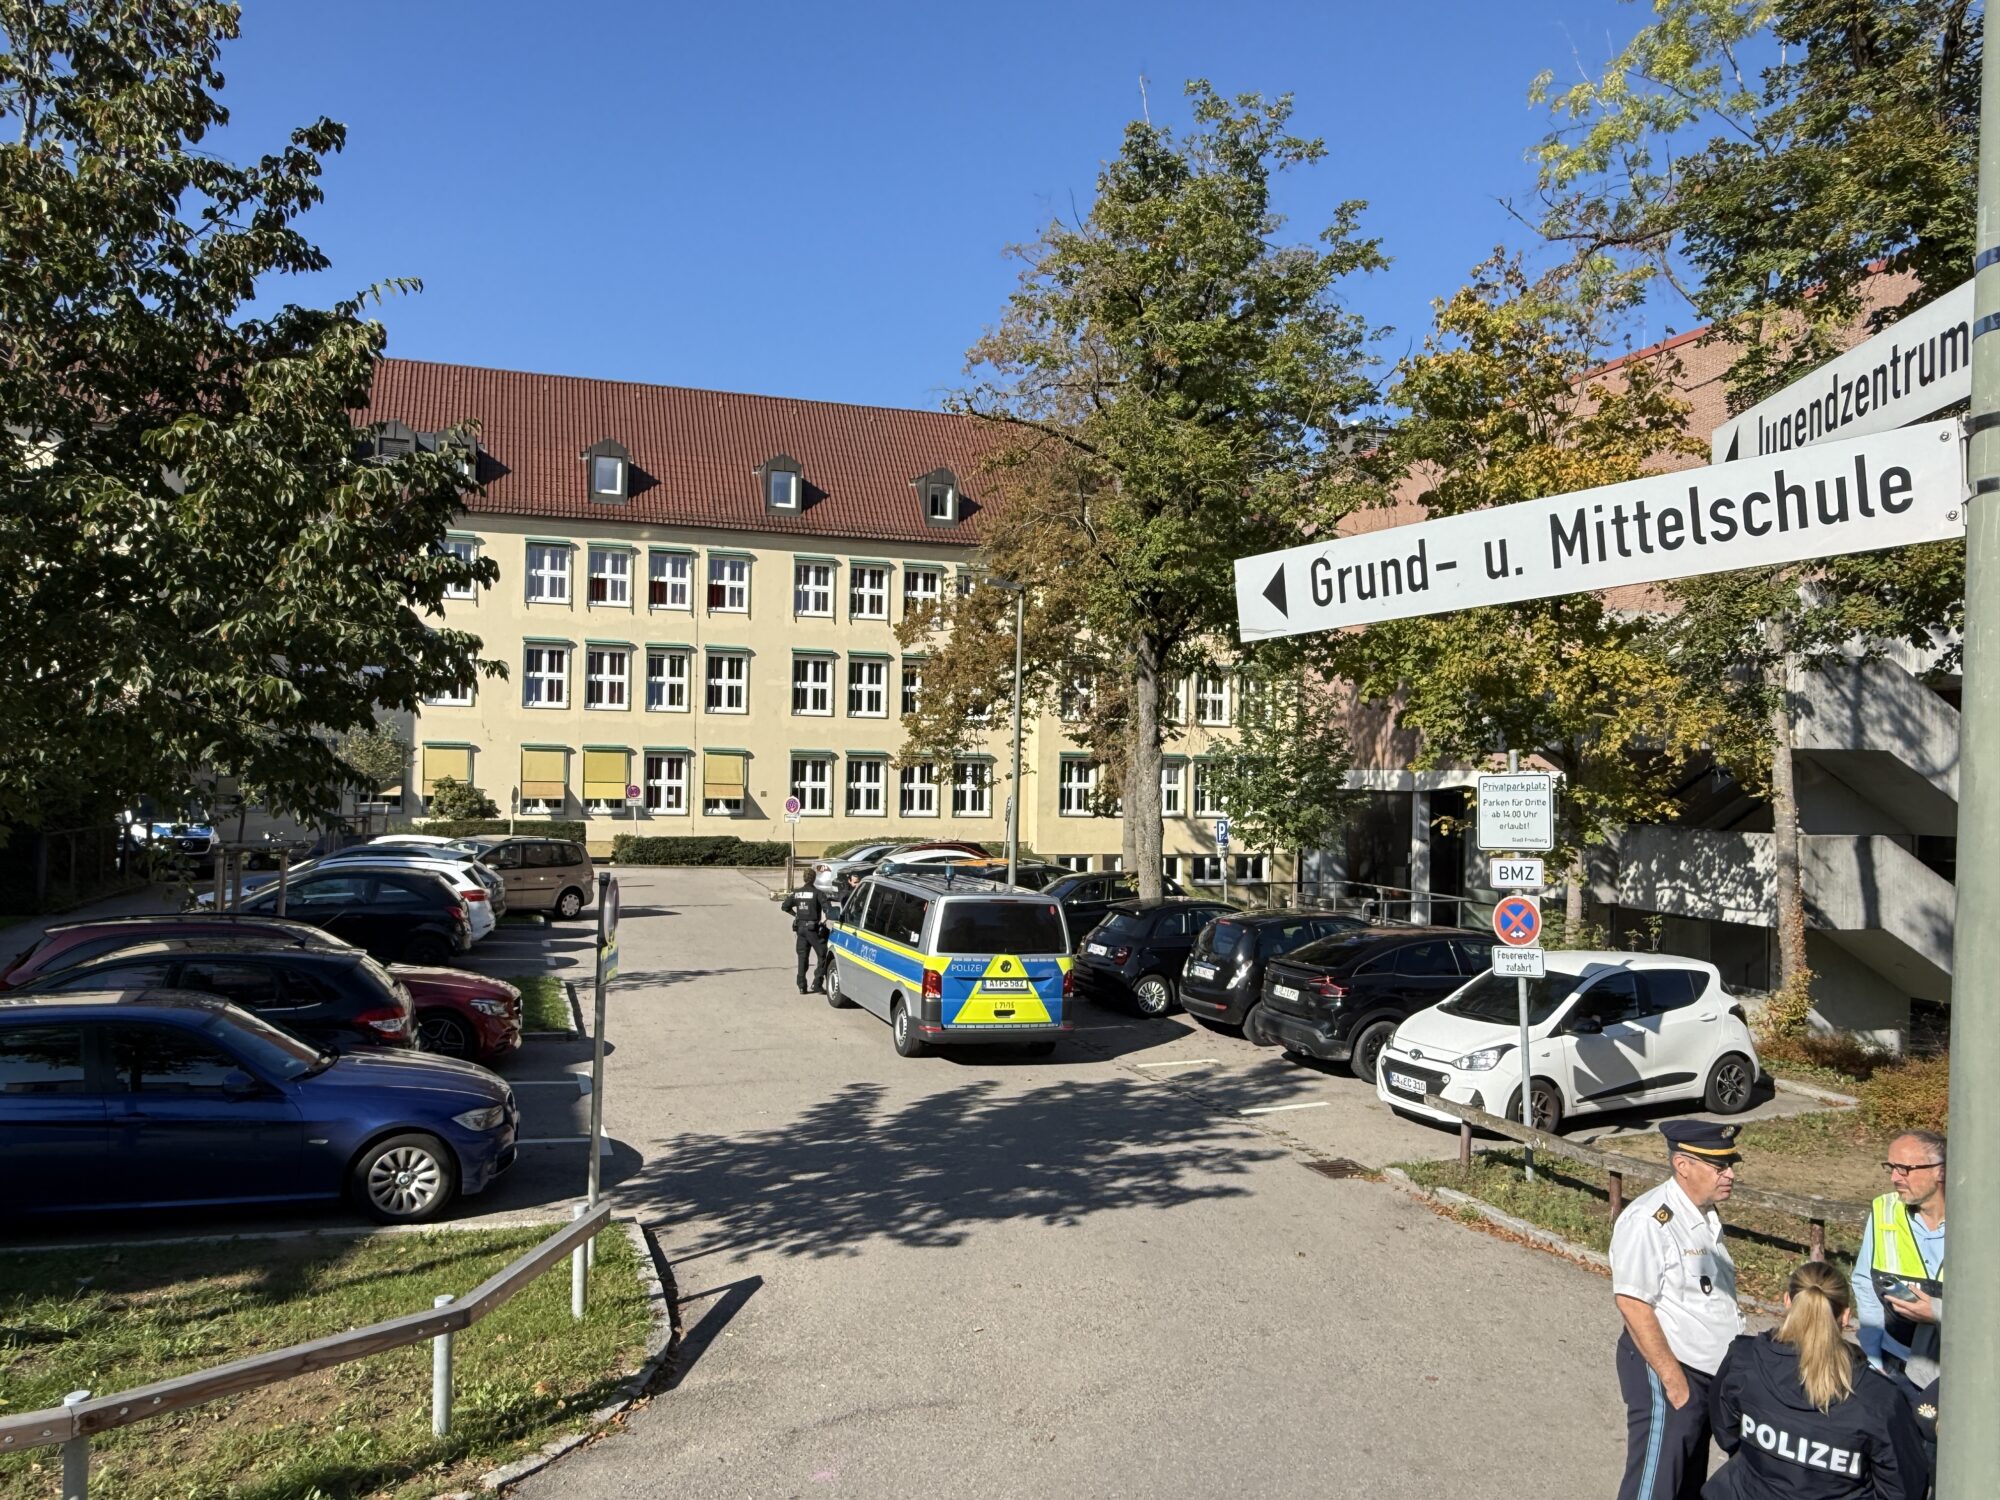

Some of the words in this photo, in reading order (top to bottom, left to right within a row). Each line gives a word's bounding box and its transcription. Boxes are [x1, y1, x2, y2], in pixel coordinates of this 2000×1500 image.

[1758, 320, 1970, 456] Jugendzentrum
[1310, 537, 1457, 608] Grund-
[1484, 538, 1524, 580] u.
[1549, 454, 1914, 570] Mittelschule
[1482, 782, 1547, 792] Privatparkplatz
[1483, 799, 1510, 807] Parken
[1511, 799, 1524, 807] für
[1525, 798, 1547, 807] Dritte
[1491, 810, 1501, 818] ab
[1522, 810, 1538, 818] Uhr
[1217, 822, 1227, 841] P
[1499, 865, 1535, 881] BMZ
[1496, 950, 1540, 961] Feuerwehr-
[951, 964, 983, 972] POLIZEI
[1505, 962, 1533, 973] zufahrt
[1741, 1412, 1861, 1475] POLIZEI
